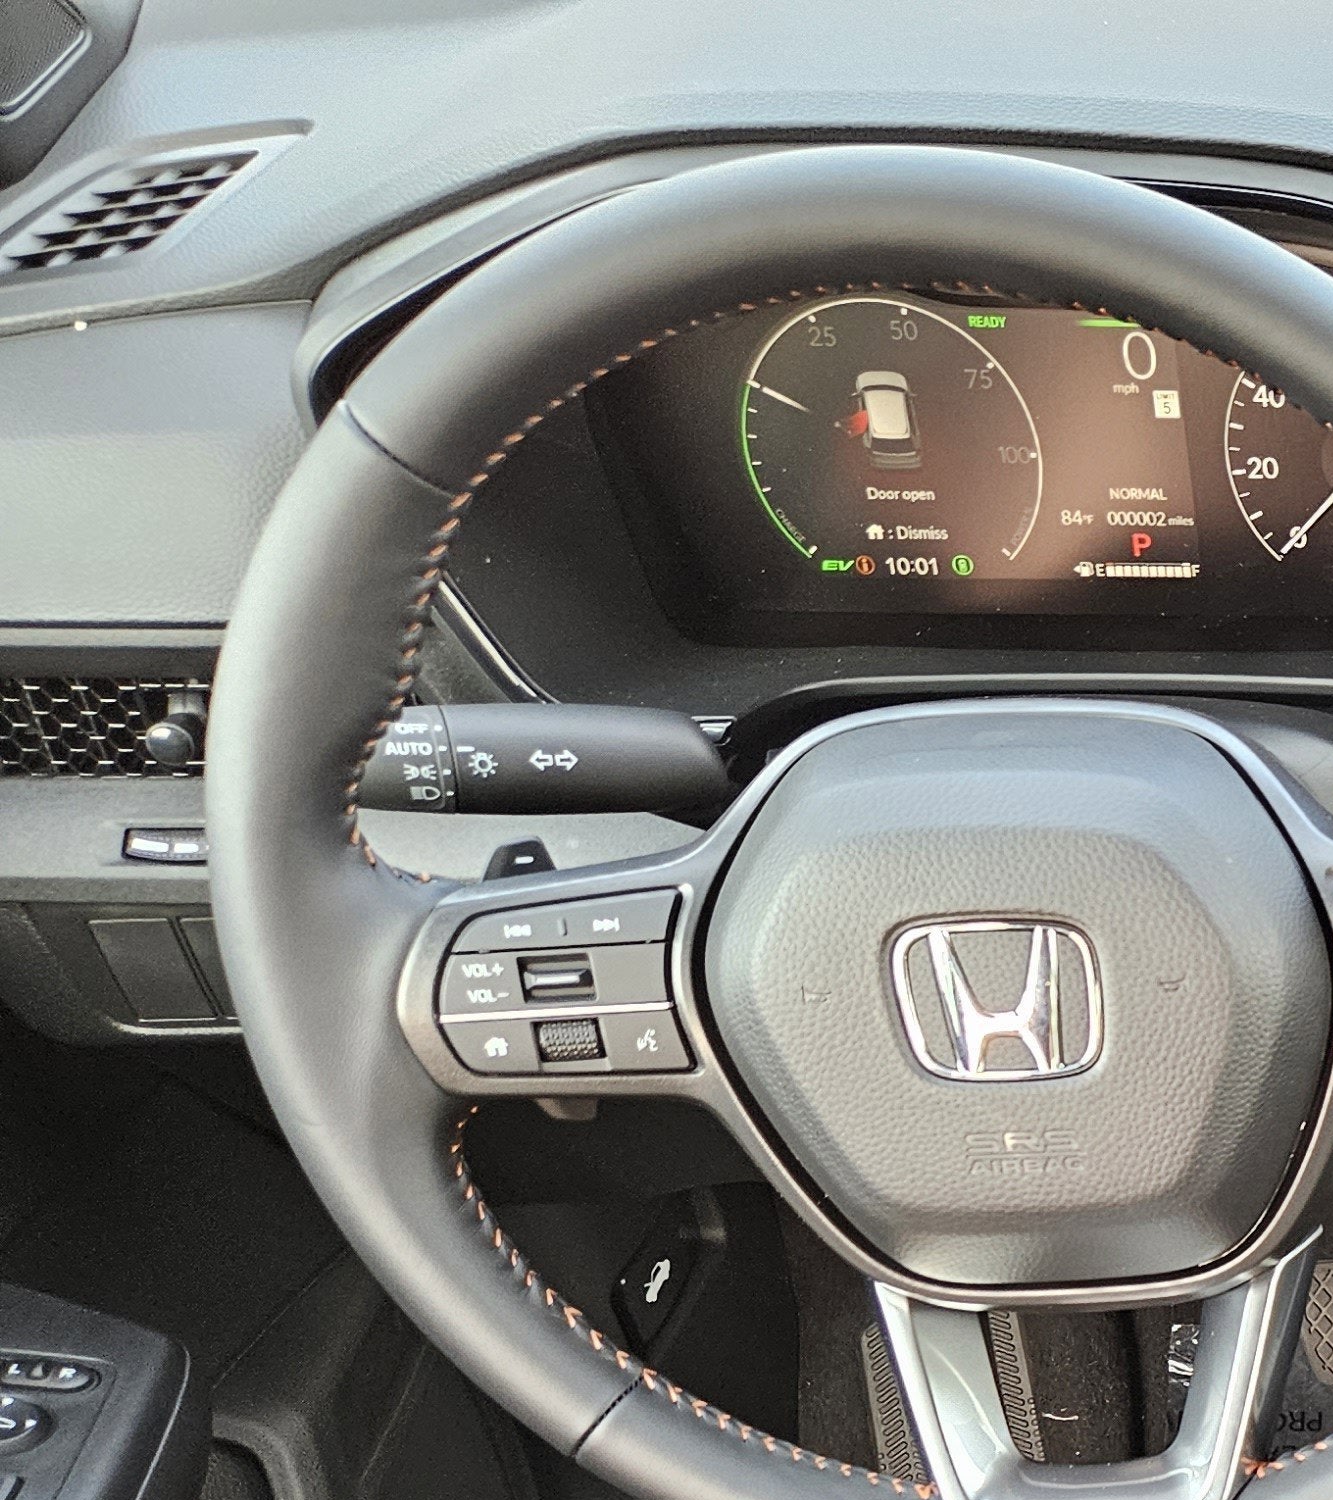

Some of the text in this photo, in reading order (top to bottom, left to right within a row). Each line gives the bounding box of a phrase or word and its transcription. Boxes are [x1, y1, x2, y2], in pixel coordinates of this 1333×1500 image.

[968, 315, 1006, 329] READY
[807, 325, 837, 347] 25
[889, 320, 918, 341] 50
[1122, 331, 1157, 380] 0
[963, 368, 993, 389] 75
[1112, 382, 1140, 395] mph
[1252, 385, 1286, 408] 40
[1163, 401, 1172, 414] 5
[998, 446, 1030, 464] 100
[1246, 456, 1280, 479] 20
[866, 487, 935, 502] Door open
[1109, 488, 1168, 501] NORMAL
[1107, 511, 1195, 527] 000002 miles
[895, 526, 949, 541] Dismiss
[1131, 532, 1152, 557] P
[821, 560, 855, 572] EV
[885, 557, 939, 576] 10:01
[1095, 563, 1106, 577] E
[1191, 564, 1201, 577] F
[394, 722, 430, 735] OFF
[385, 741, 433, 756] AUTO
